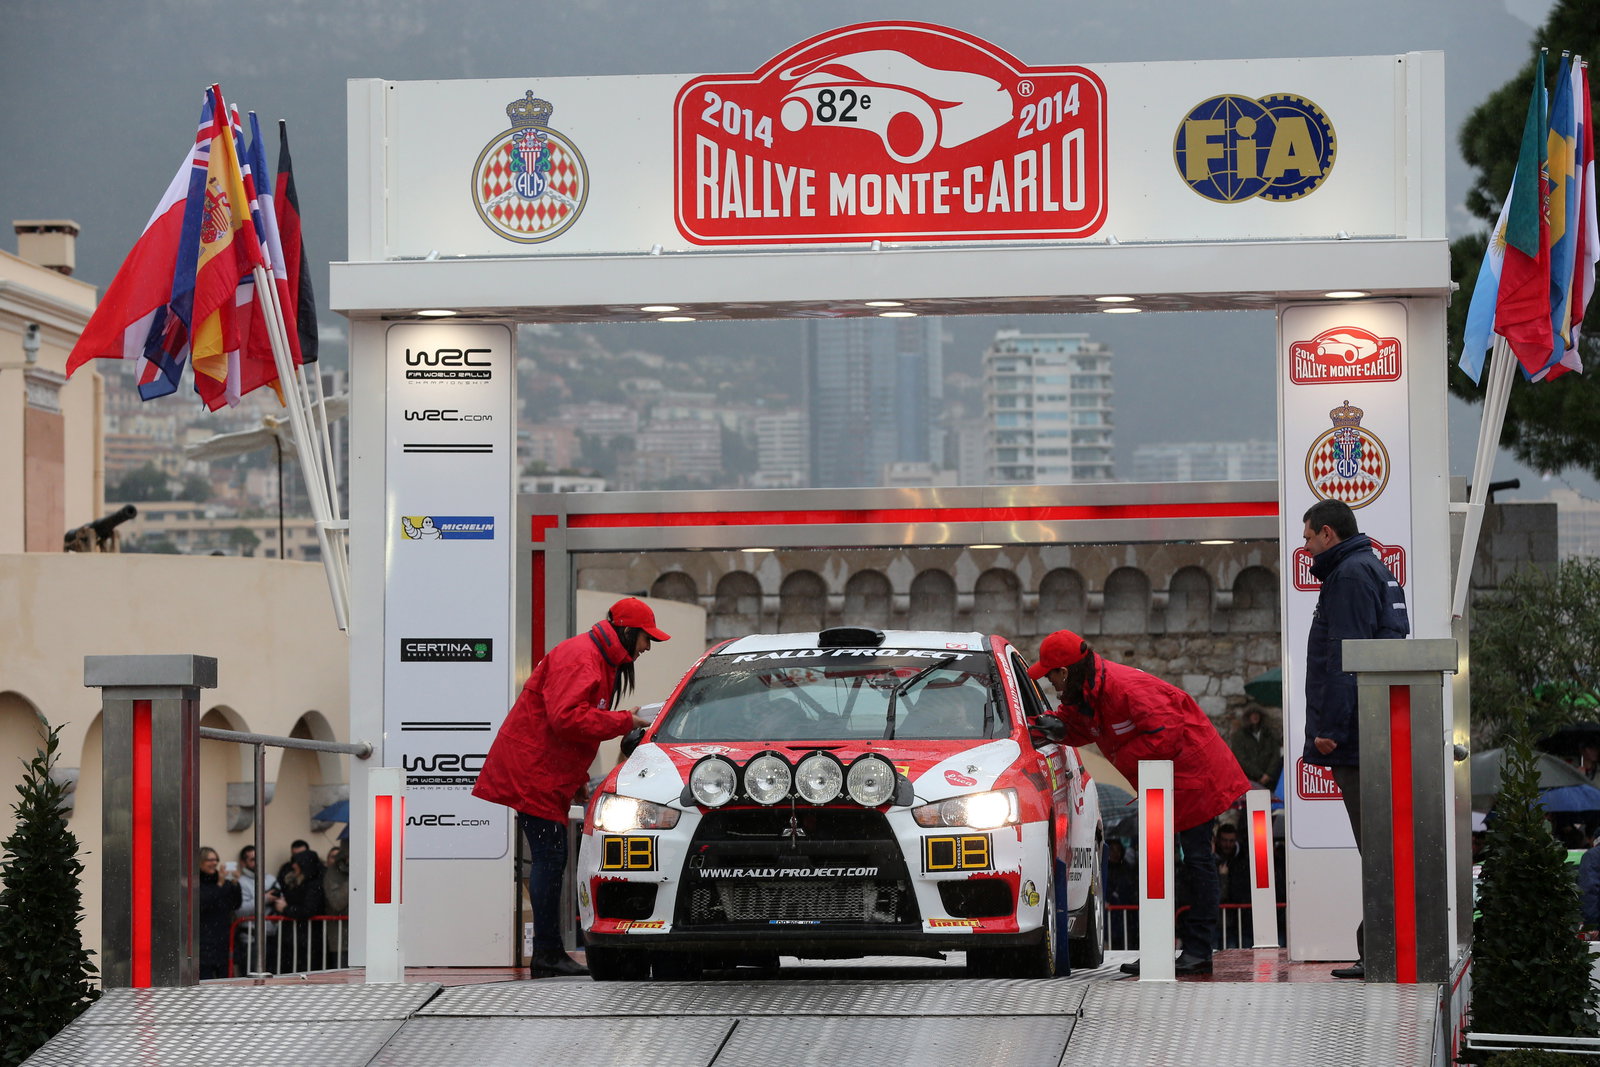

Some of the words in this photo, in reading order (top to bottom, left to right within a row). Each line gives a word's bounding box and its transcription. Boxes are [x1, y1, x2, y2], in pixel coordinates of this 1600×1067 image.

[1017, 83, 1080, 139] 2014
[701, 91, 774, 148] 2014
[696, 133, 816, 220] RALLYE
[829, 127, 1085, 217] MONTE-CARLO
[406, 348, 492, 367] WRC
[1295, 347, 1315, 362] 2014
[1379, 344, 1396, 359] 2014
[1296, 356, 1328, 379] RALLYE
[1330, 354, 1396, 377] MONTE-CARLO
[441, 523, 494, 531] MICHELIN
[1299, 553, 1314, 566] 201
[1383, 551, 1400, 566] 2014
[406, 643, 472, 651] CERTINA
[403, 754, 488, 772] WRC
[1303, 763, 1323, 778] 2014
[1303, 771, 1335, 794] RALLYE
[616, 921, 665, 930] PIRELLI
[928, 918, 981, 928] PIRELLI
